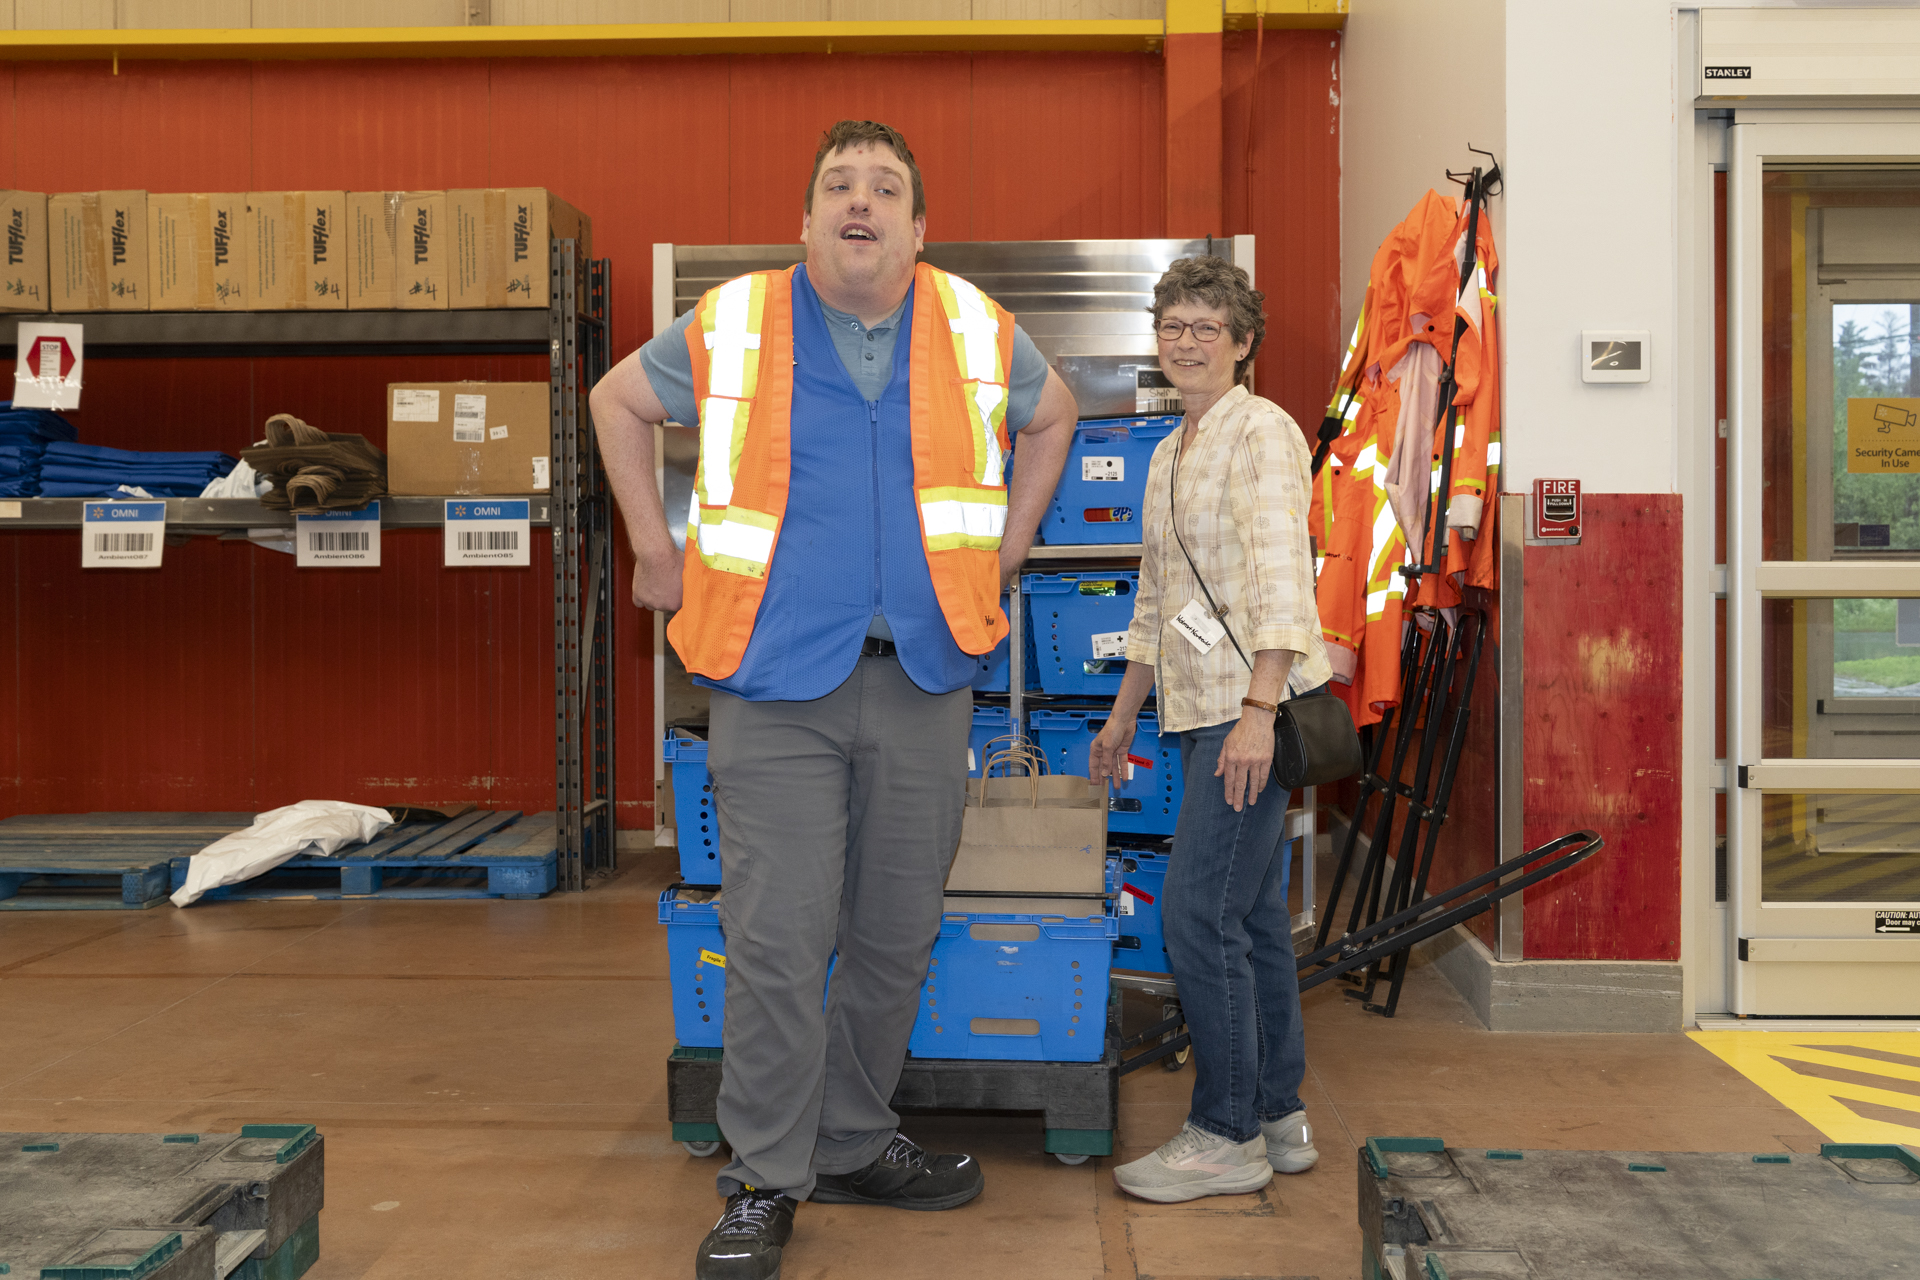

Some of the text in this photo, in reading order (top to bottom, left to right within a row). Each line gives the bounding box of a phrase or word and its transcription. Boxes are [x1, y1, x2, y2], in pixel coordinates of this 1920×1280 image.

[1706, 69, 1749, 77] STANLEY
[1855, 447, 1894, 459] Security
[1881, 459, 1910, 468] In Use
[1543, 481, 1576, 493] FIRE
[111, 509, 139, 518] OMNI
[473, 507, 501, 516] OMNI
[1876, 911, 1908, 919] CAUTION:
